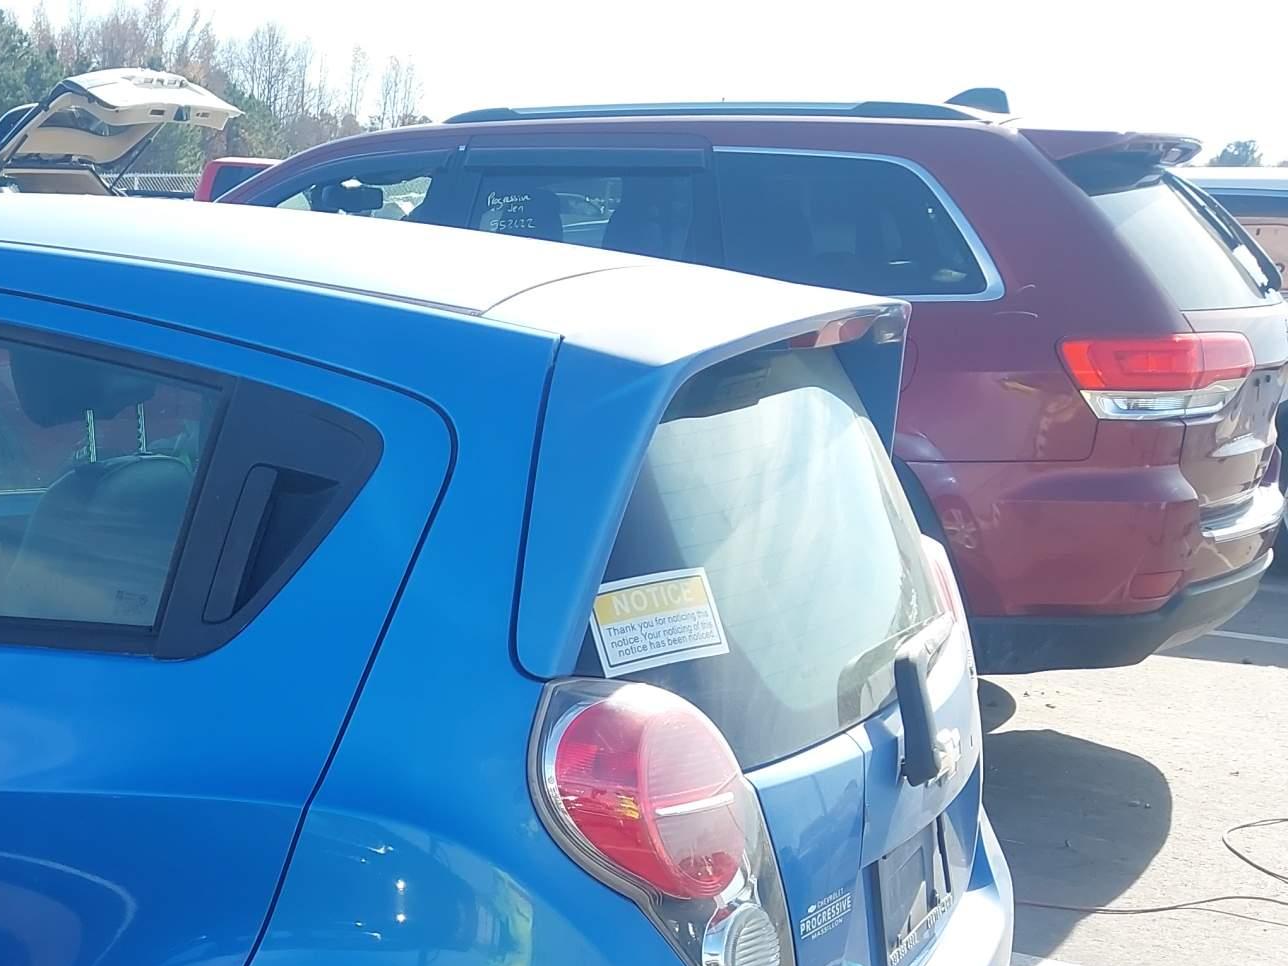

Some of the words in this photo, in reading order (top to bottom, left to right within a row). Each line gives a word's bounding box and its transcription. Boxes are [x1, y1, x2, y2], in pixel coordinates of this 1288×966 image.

[611, 583, 695, 616] NOTICE
[606, 623, 637, 637] Thank
[638, 619, 654, 635] you
[655, 616, 666, 626] for
[667, 611, 697, 624] noticing
[662, 624, 693, 636] noticing
[618, 643, 649, 657] notice
[649, 639, 666, 650] has
[667, 635, 687, 646] been
[799, 895, 852, 936] PROGRESSIVE
